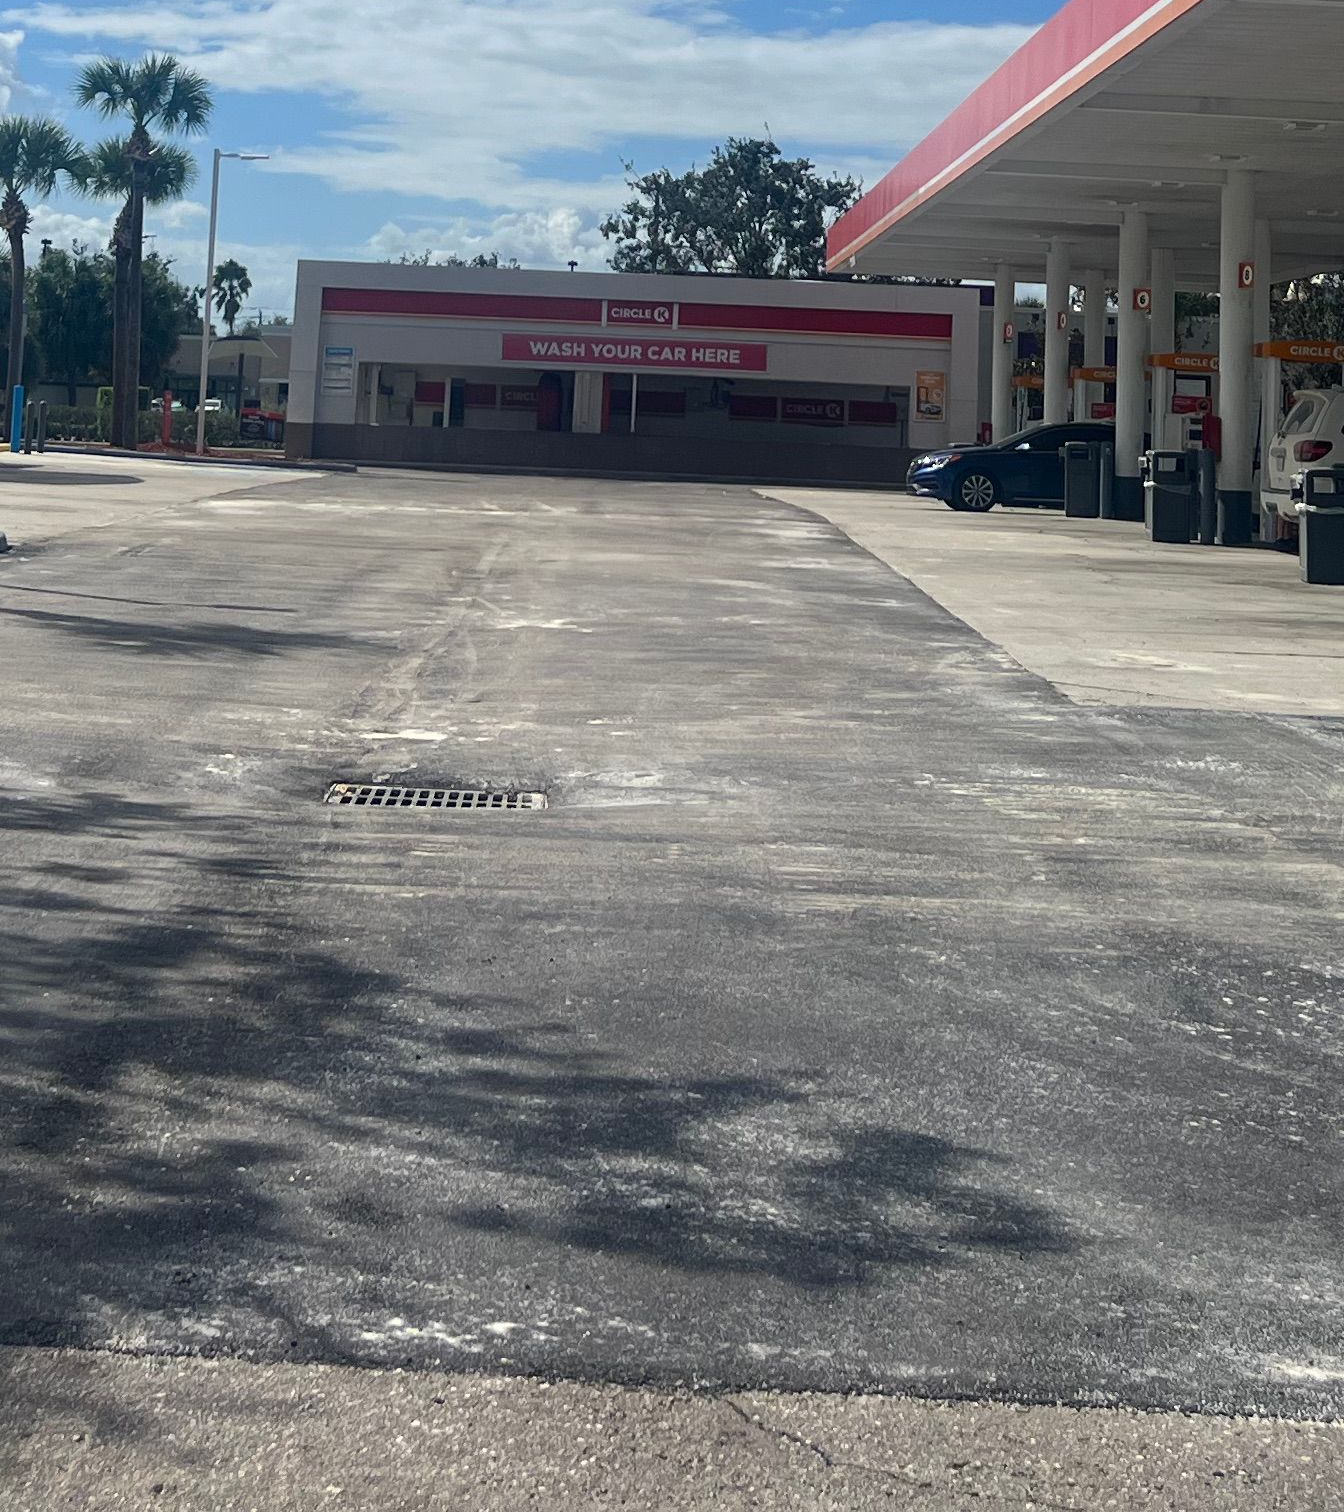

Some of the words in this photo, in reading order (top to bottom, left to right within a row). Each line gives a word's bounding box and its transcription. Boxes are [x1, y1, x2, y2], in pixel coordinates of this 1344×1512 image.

[1139, 295, 1146, 305] 6
[611, 307, 652, 319] CIRCLE
[655, 307, 669, 322] K
[529, 341, 585, 357] WASH
[591, 343, 642, 360] YOUR
[647, 346, 687, 362] CAR
[691, 348, 741, 364] HERE
[1289, 345, 1331, 357] CIRCLE
[1174, 356, 1208, 368] CIRCLE
[785, 403, 824, 415] CIRCLE
